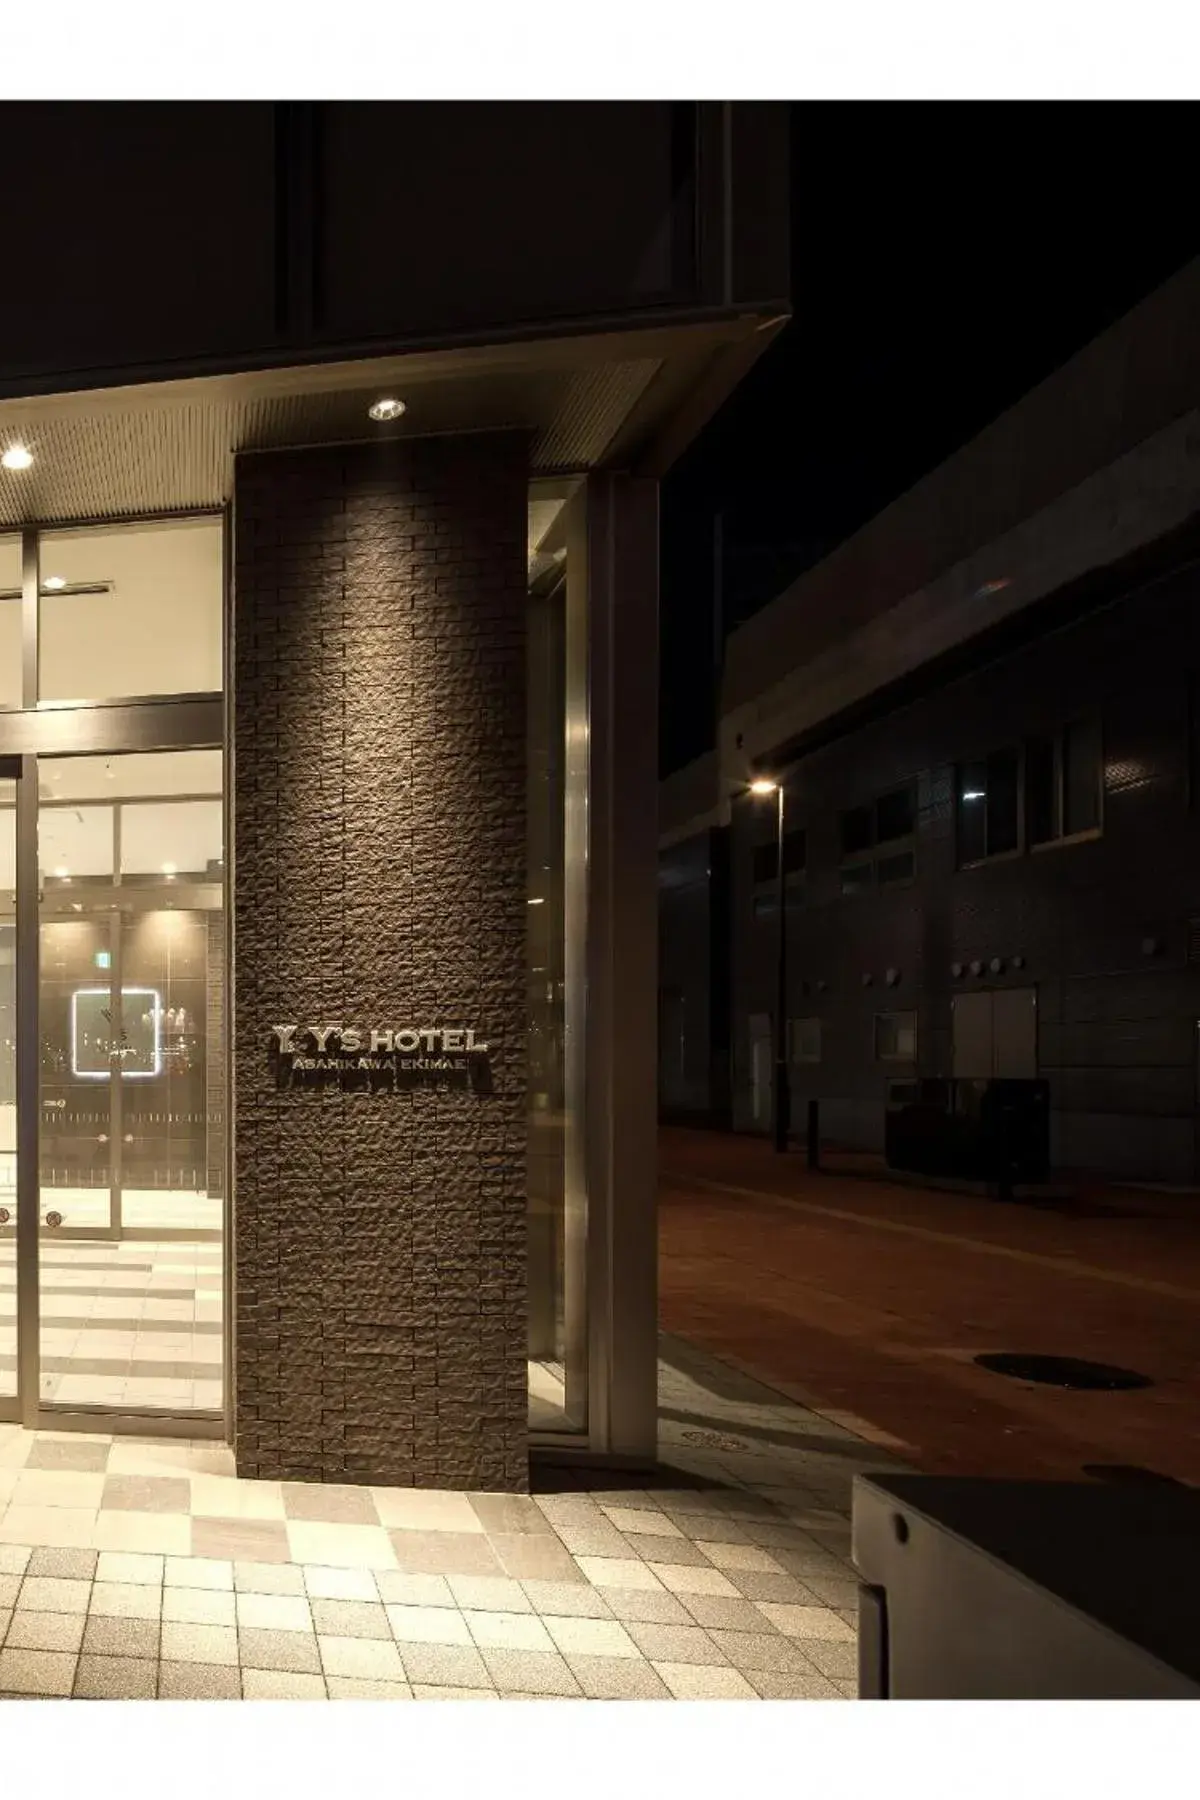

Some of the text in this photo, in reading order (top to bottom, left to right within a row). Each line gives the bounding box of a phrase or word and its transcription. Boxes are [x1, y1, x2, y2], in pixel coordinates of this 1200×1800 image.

[307, 1027, 361, 1052] Y'S
[370, 1030, 488, 1052] HOTEL
[292, 1058, 467, 1070] ASAHIKAWA EKIMAE
